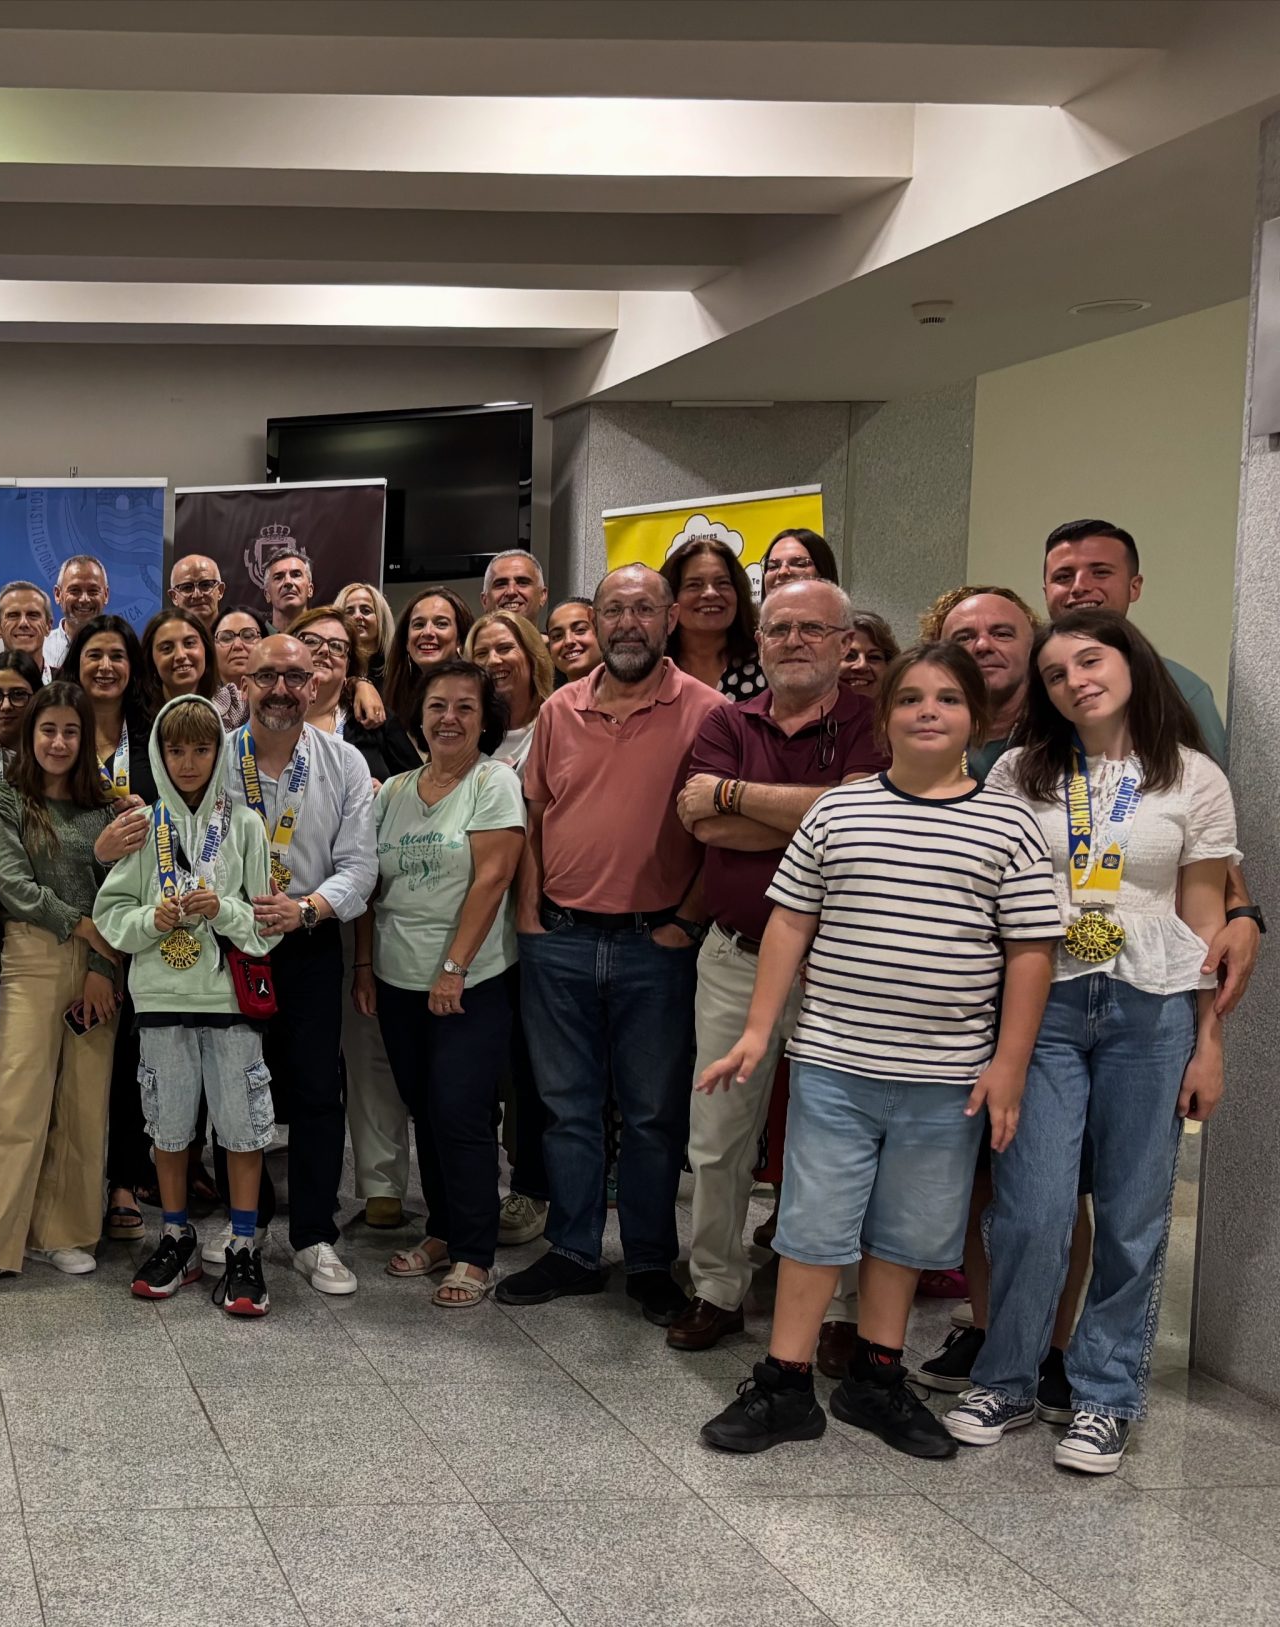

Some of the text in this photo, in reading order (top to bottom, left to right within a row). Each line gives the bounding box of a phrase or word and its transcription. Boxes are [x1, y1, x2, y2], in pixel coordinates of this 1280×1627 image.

[752, 577, 761, 585] Te
[241, 754, 262, 805] SANTIAGO
[288, 754, 306, 794] SANTIAGO
[1068, 775, 1091, 836] SANTIAGO
[1109, 776, 1138, 823] SANTIAGO
[156, 824, 174, 874] SANTIAGO
[200, 824, 219, 863] SANTIAGO
